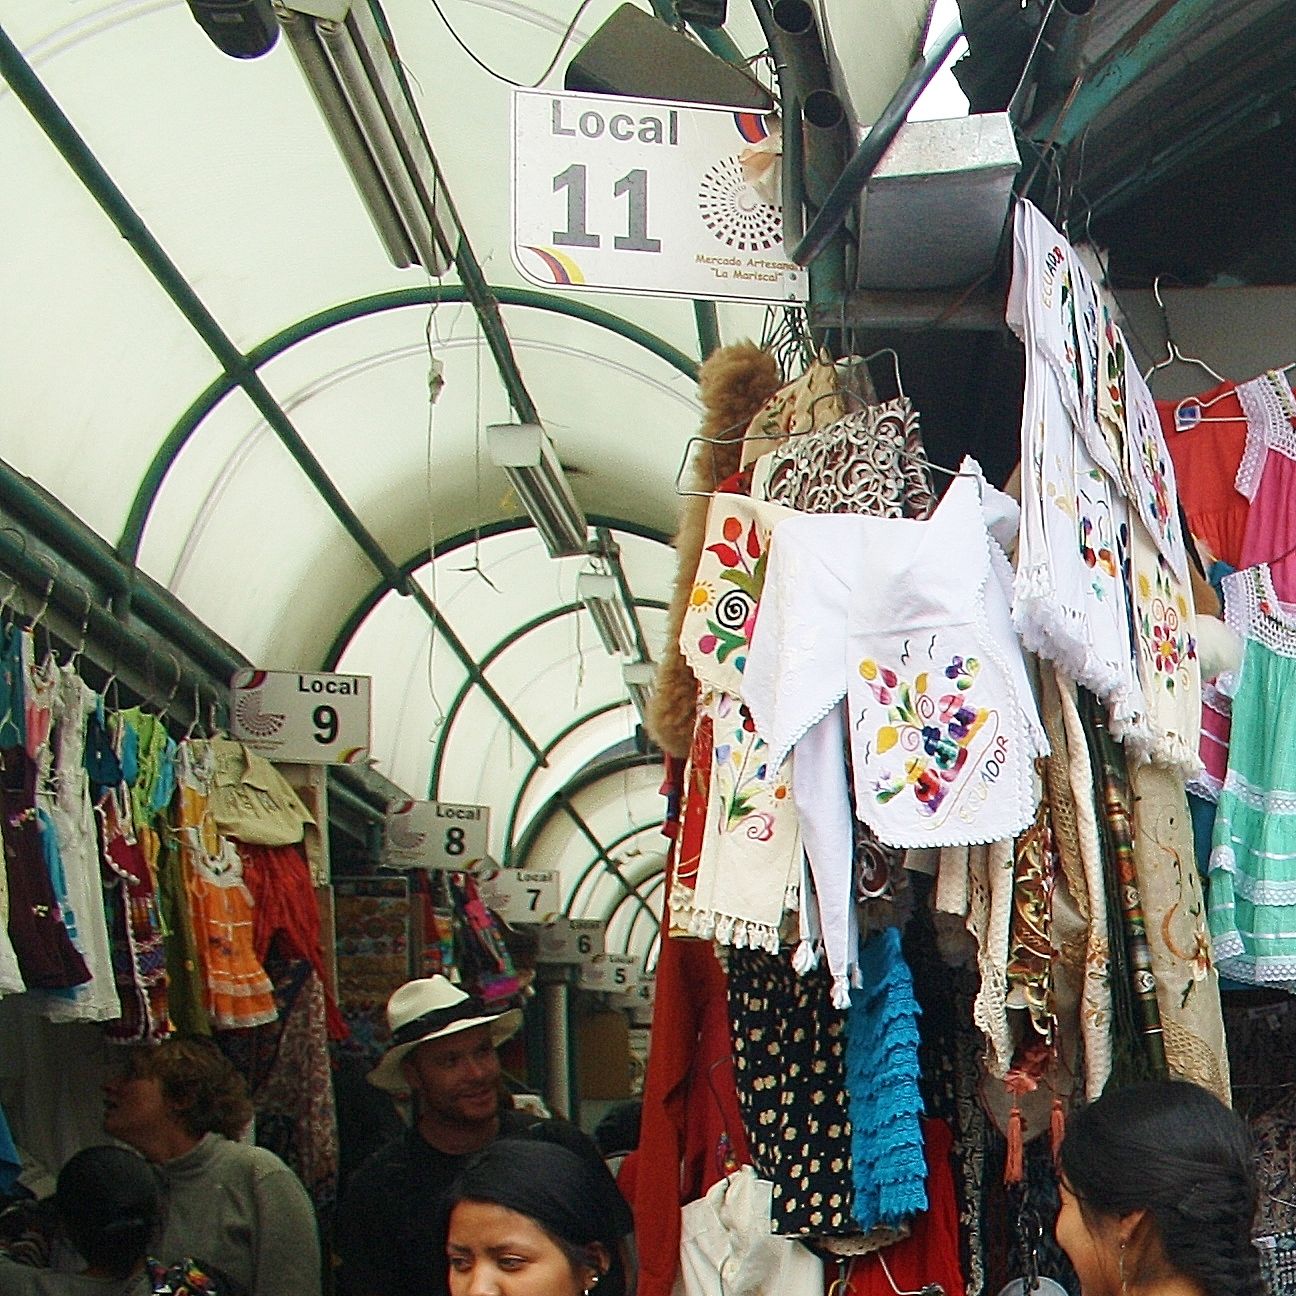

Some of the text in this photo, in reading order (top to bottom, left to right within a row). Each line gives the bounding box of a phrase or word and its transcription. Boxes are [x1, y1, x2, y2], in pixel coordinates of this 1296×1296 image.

[552, 99, 679, 146] Local
[552, 163, 662, 253] 11
[695, 254, 742, 267] Mercado
[298, 675, 359, 696] Local
[312, 704, 340, 745] 9
[436, 804, 481, 821] Local
[445, 826, 465, 856] 8
[517, 872, 553, 882] Local
[526, 888, 541, 911] 7
[578, 934, 591, 954] 6
[614, 967, 626, 984] 5
